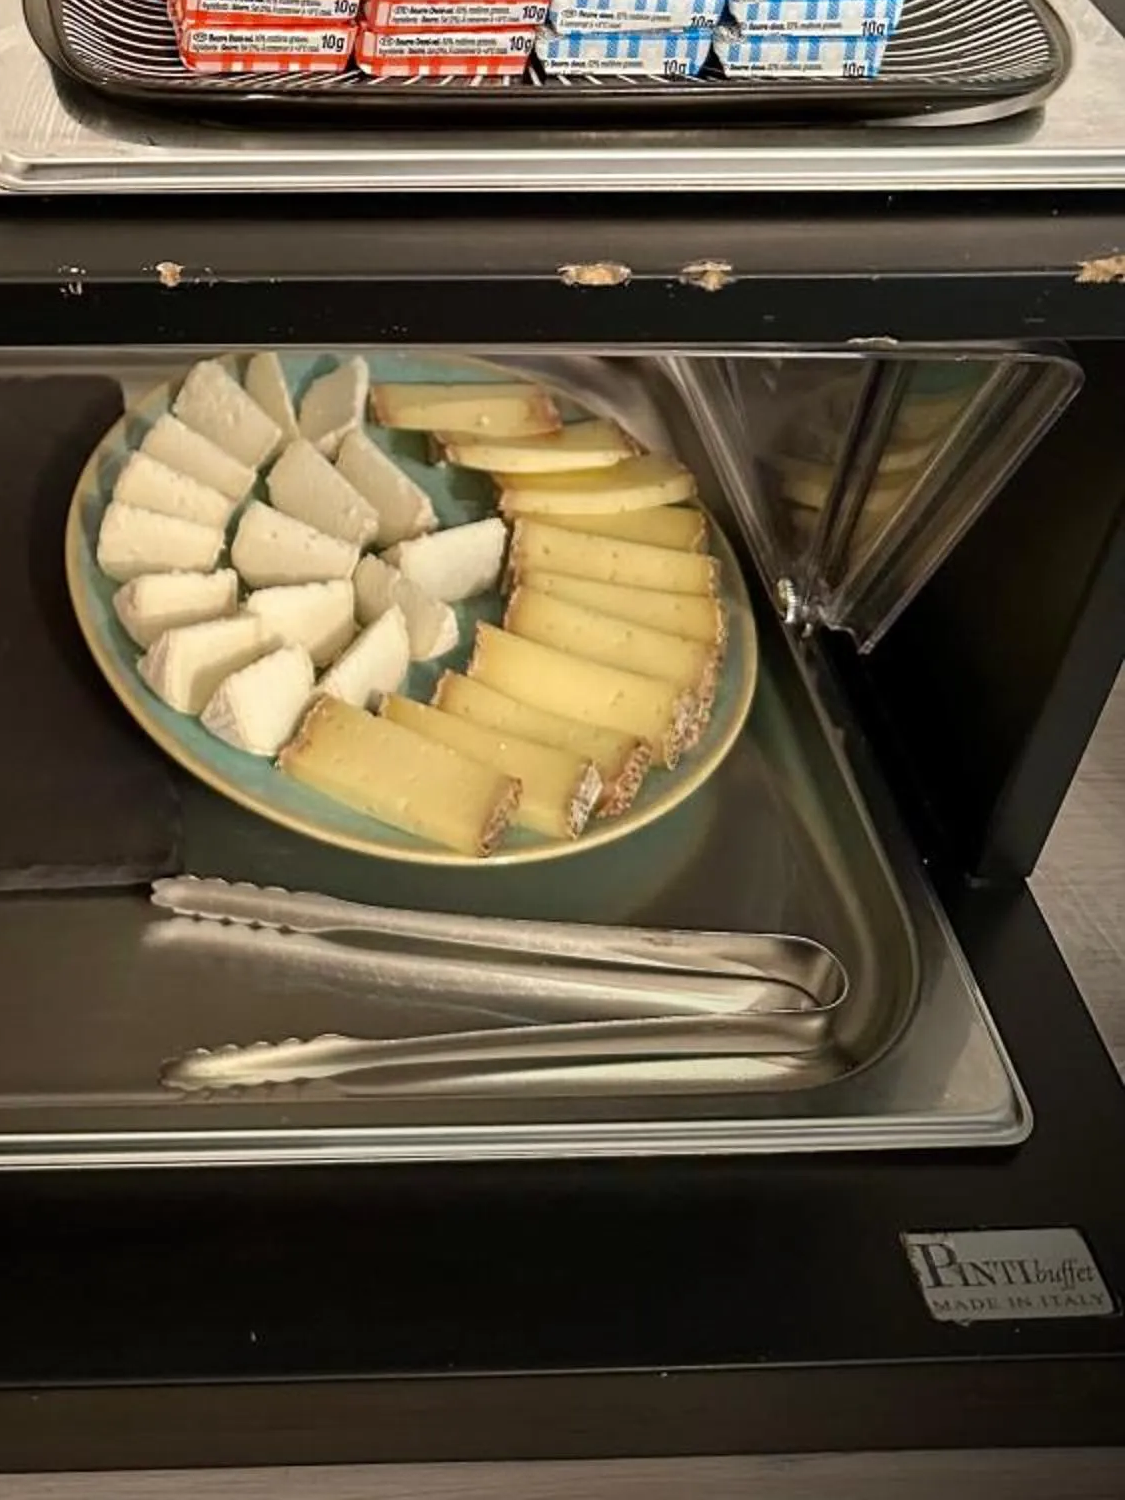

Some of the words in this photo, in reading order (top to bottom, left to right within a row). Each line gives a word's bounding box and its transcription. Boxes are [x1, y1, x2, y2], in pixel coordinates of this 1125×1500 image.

[333, 0, 358, 15] 10g
[522, 5, 546, 22] 10g
[321, 33, 345, 51] 10g
[509, 36, 532, 53] 10g
[1034, 1258, 1095, 1291] buffet
[932, 1296, 1000, 1312] MADE
[1009, 1296, 1032, 1309] IN
[1041, 1293, 1105, 1309] ITALY
